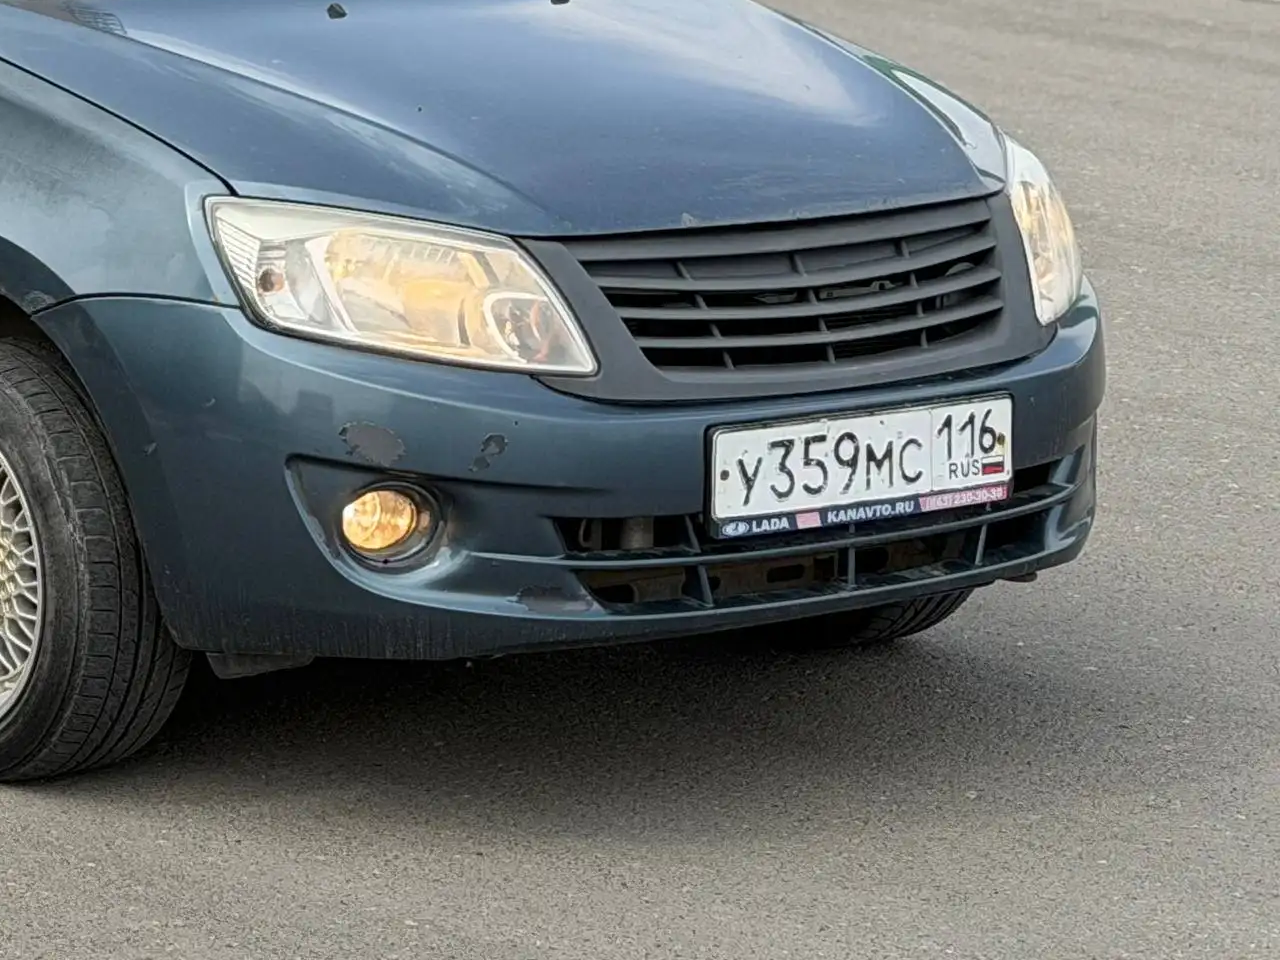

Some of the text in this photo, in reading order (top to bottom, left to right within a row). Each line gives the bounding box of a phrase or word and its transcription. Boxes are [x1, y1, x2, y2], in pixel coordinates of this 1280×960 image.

[936, 408, 997, 459] 116
[948, 458, 980, 480] RUS
[752, 516, 790, 533] LADA
[826, 500, 915, 524] KANAVTO.RU
